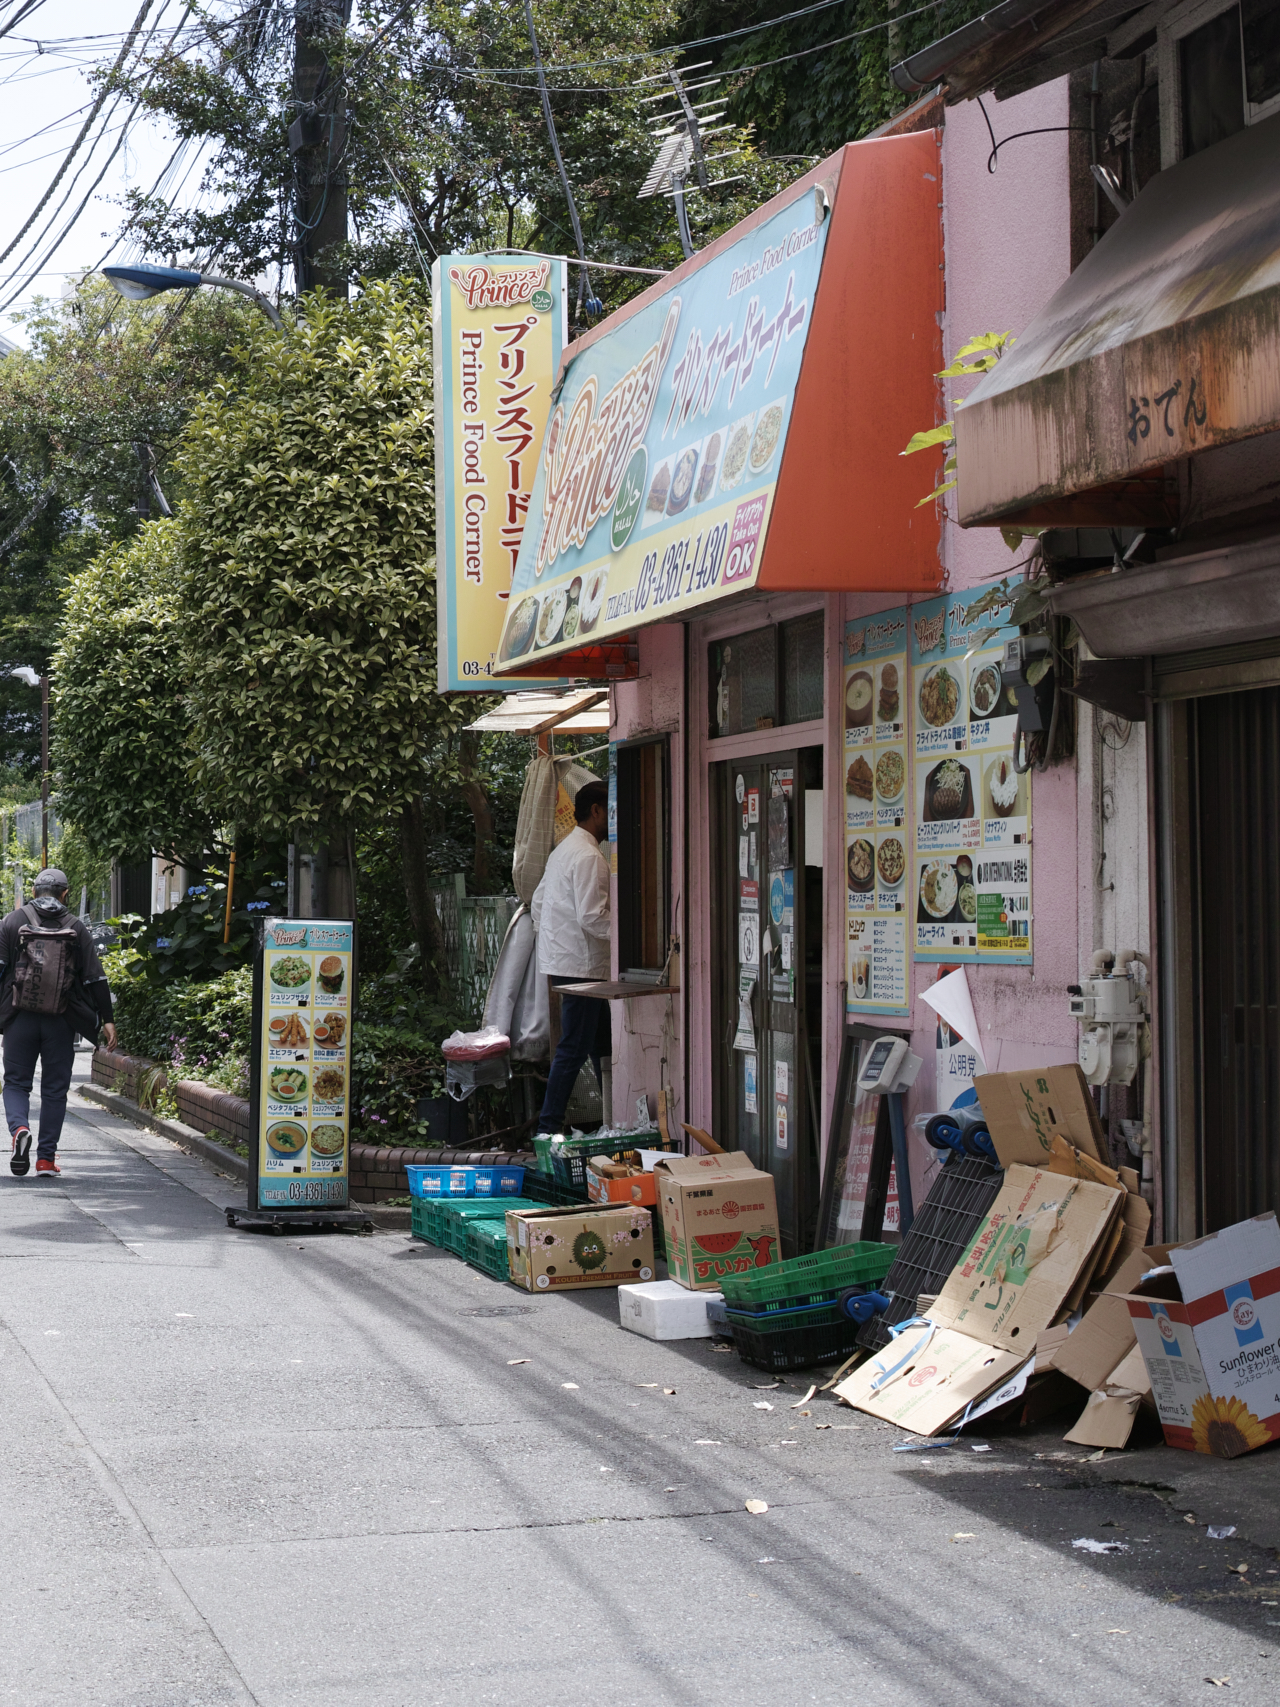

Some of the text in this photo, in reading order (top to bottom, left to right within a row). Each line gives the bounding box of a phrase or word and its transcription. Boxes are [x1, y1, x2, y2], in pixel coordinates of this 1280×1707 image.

[728, 224, 820, 297] Prince Food Corner
[499, 270, 538, 284] プリンス
[464, 267, 534, 306] Prince
[662, 275, 806, 438] プリンスフードコーナー
[1128, 377, 1207, 446] おでん
[462, 331, 487, 584] Prince Food Corner
[613, 515, 632, 533] HALAL
[732, 521, 760, 542] Take Out
[634, 521, 728, 613] 03-4361-1430
[725, 541, 755, 579] OK
[949, 633, 967, 648] Prince
[462, 660, 496, 677] 03-4
[846, 727, 869, 739] コーンスープ
[970, 721, 990, 736] 牛タン丼
[877, 807, 904, 817] ベジタブルピザ
[848, 893, 874, 904] チキンステーキ
[878, 893, 898, 903] チキンピザ
[849, 919, 865, 932] ドリンク
[918, 926, 945, 938] カレーライス
[270, 993, 309, 1001] シュリンプサラダ
[949, 1054, 977, 1077] 公明党
[289, 1182, 344, 1200] 03-4361-1430
[686, 1189, 713, 1199] 千葉県産
[696, 1208, 721, 1217] まるあさ
[694, 1256, 753, 1277] すいか
[555, 1276, 580, 1284] KOUEI
[1220, 1344, 1275, 1374] Sunflower
[1237, 1353, 1280, 1378] ひまわり油
[1233, 1368, 1274, 1389] コレステロール
